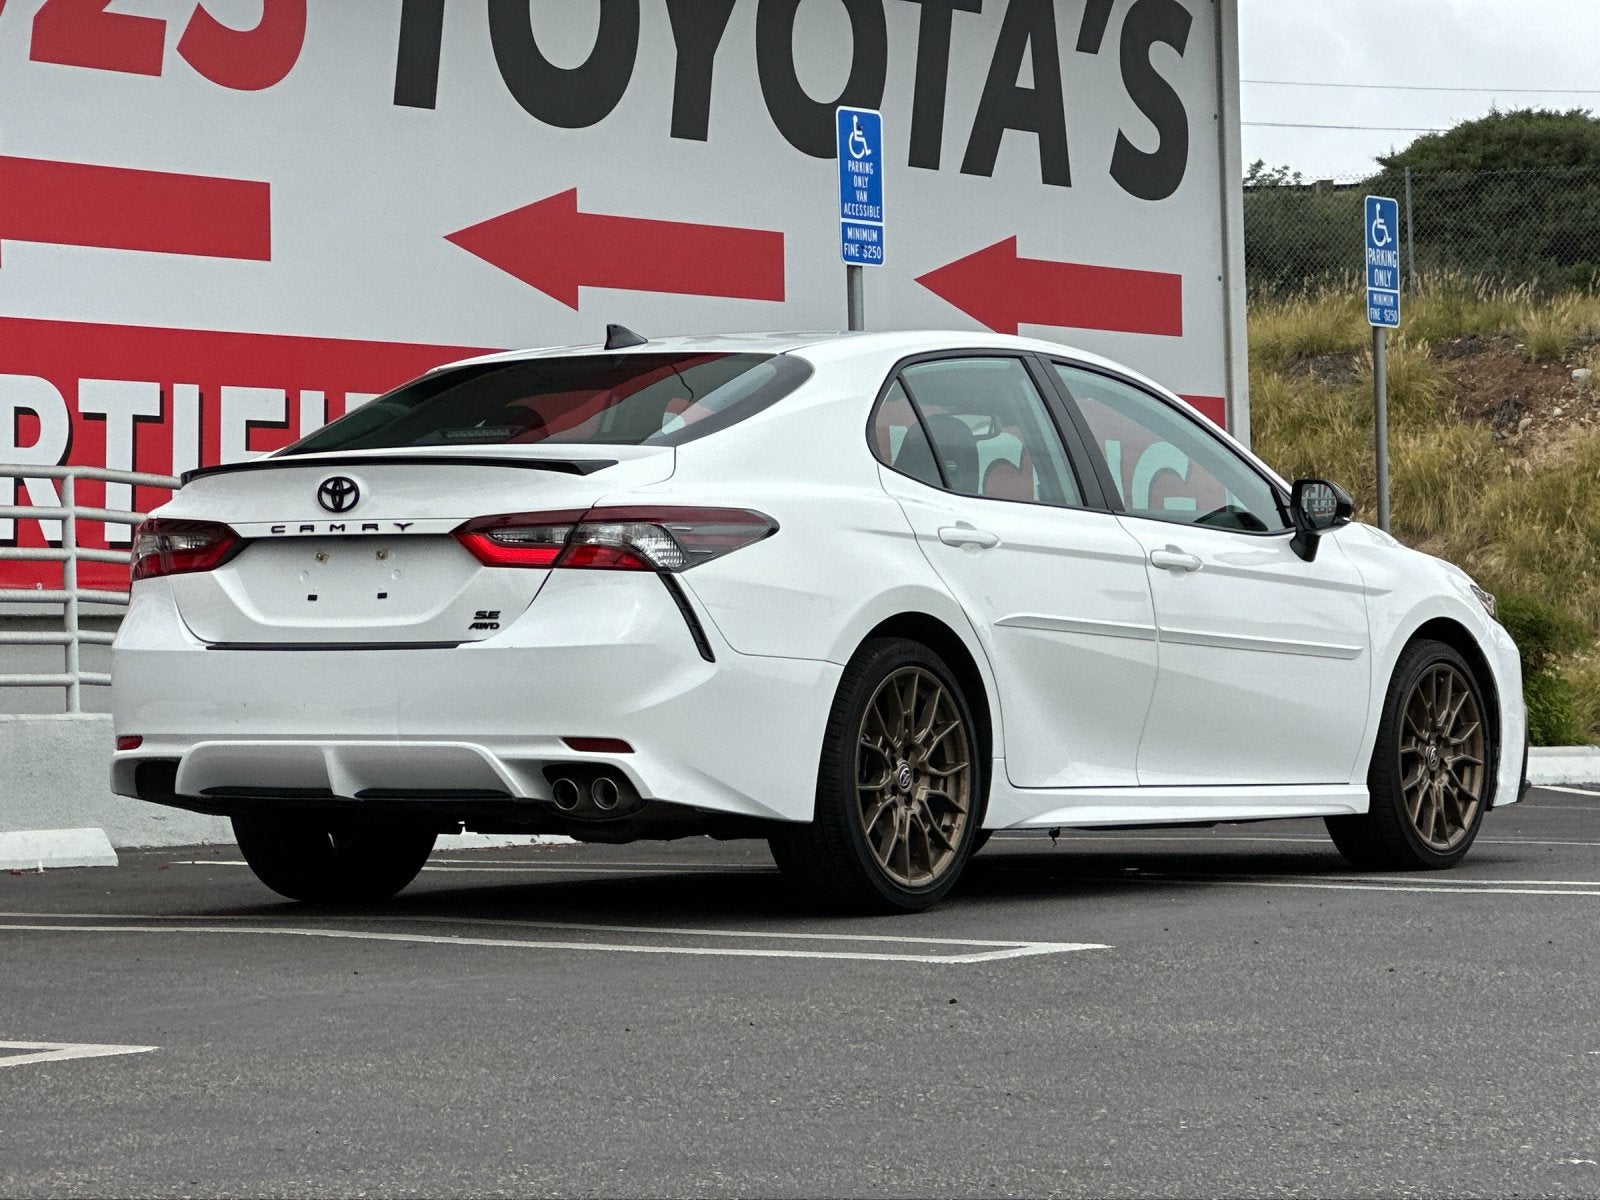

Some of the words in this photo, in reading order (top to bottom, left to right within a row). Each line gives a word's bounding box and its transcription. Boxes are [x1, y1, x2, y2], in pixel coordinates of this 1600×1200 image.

[848, 160, 874, 175] PARKING
[853, 175, 869, 188] ONLY
[856, 190, 868, 203] VAN
[844, 203, 881, 219] ACCESSIBLE
[847, 227, 878, 242] MINIMUM
[844, 243, 860, 257] FINE
[862, 245, 882, 260] $250
[1368, 247, 1397, 268] PARKING
[1374, 268, 1392, 287] ONLY
[270, 522, 415, 534] CAMRY
[473, 610, 502, 620] SE
[468, 622, 500, 630] AWD
